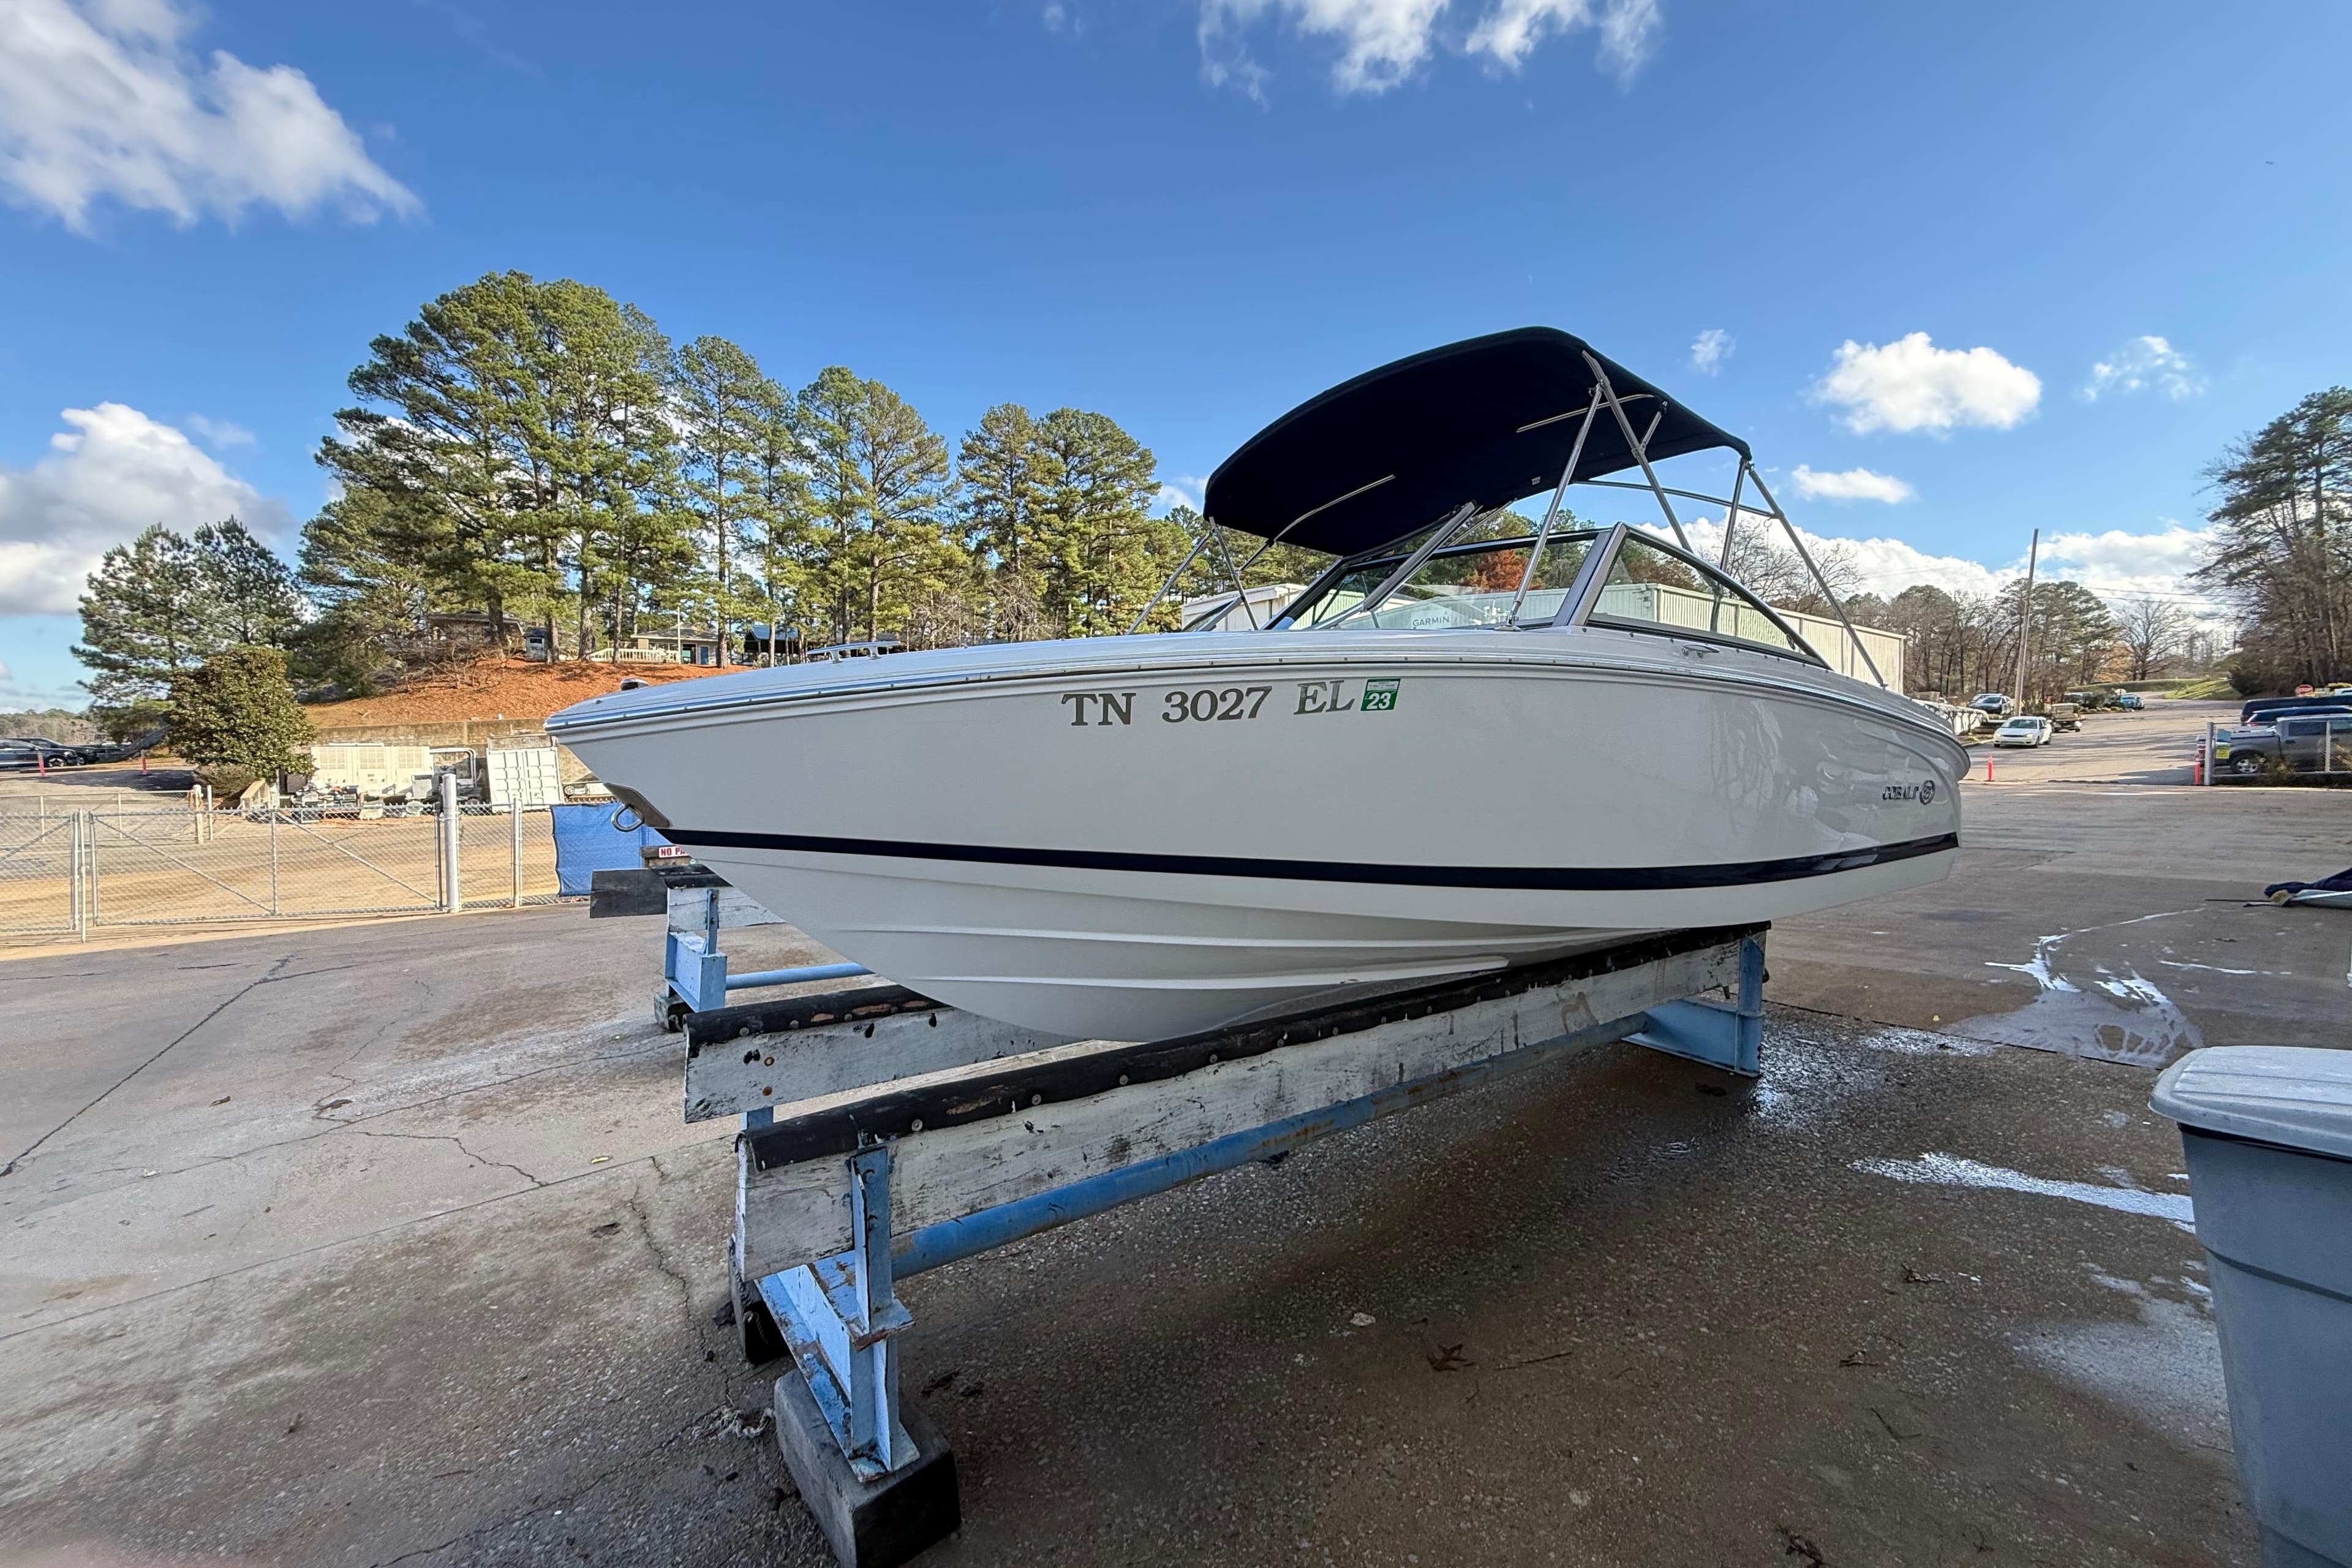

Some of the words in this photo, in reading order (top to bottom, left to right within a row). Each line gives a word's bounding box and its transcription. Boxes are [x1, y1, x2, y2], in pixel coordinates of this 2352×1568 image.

[1412, 616, 1449, 627] GARMIN
[1061, 693, 1136, 726] TN
[1162, 686, 1272, 723] 3027
[1294, 680, 1354, 715] EL
[1366, 692, 1391, 709] 23
[661, 848, 672, 856] NO
